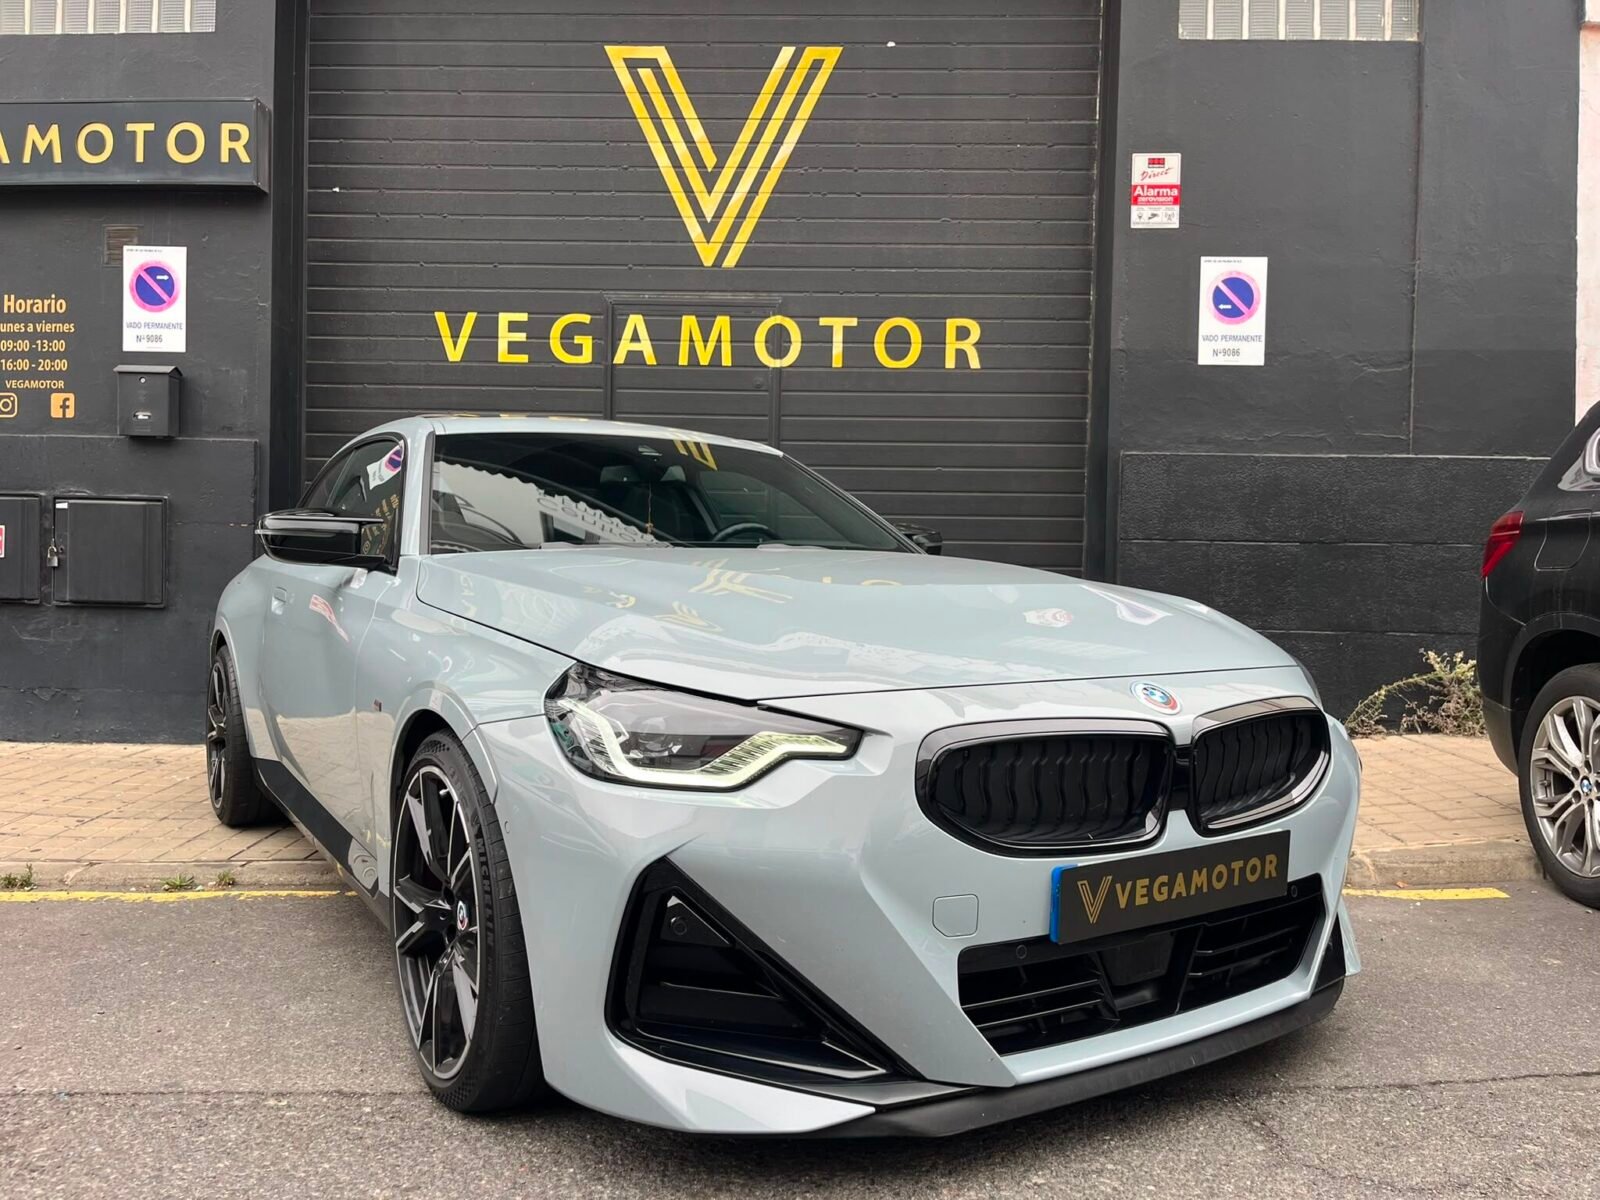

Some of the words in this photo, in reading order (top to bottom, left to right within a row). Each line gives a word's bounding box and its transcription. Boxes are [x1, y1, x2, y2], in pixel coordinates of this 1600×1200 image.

[1133, 185, 1179, 197] Alarma
[3, 293, 67, 314] Horario
[0, 322, 25, 333] unes
[27, 322, 34, 333] a
[35, 320, 75, 333] viernes
[126, 321, 142, 330] VADO
[143, 321, 183, 331] PERMANENTE
[435, 311, 982, 369] VEGAMOTOR
[1201, 334, 1219, 343] VADO
[1220, 334, 1263, 343] PERMANENTE
[0, 339, 30, 352] 09:00
[1, 359, 30, 371] 16:00
[37, 359, 68, 371] 20:00
[5, 379, 65, 389] VEGAMOTOR
[1115, 854, 1278, 910] VEGAMOTOR
[476, 838, 495, 946] MICHELIN
